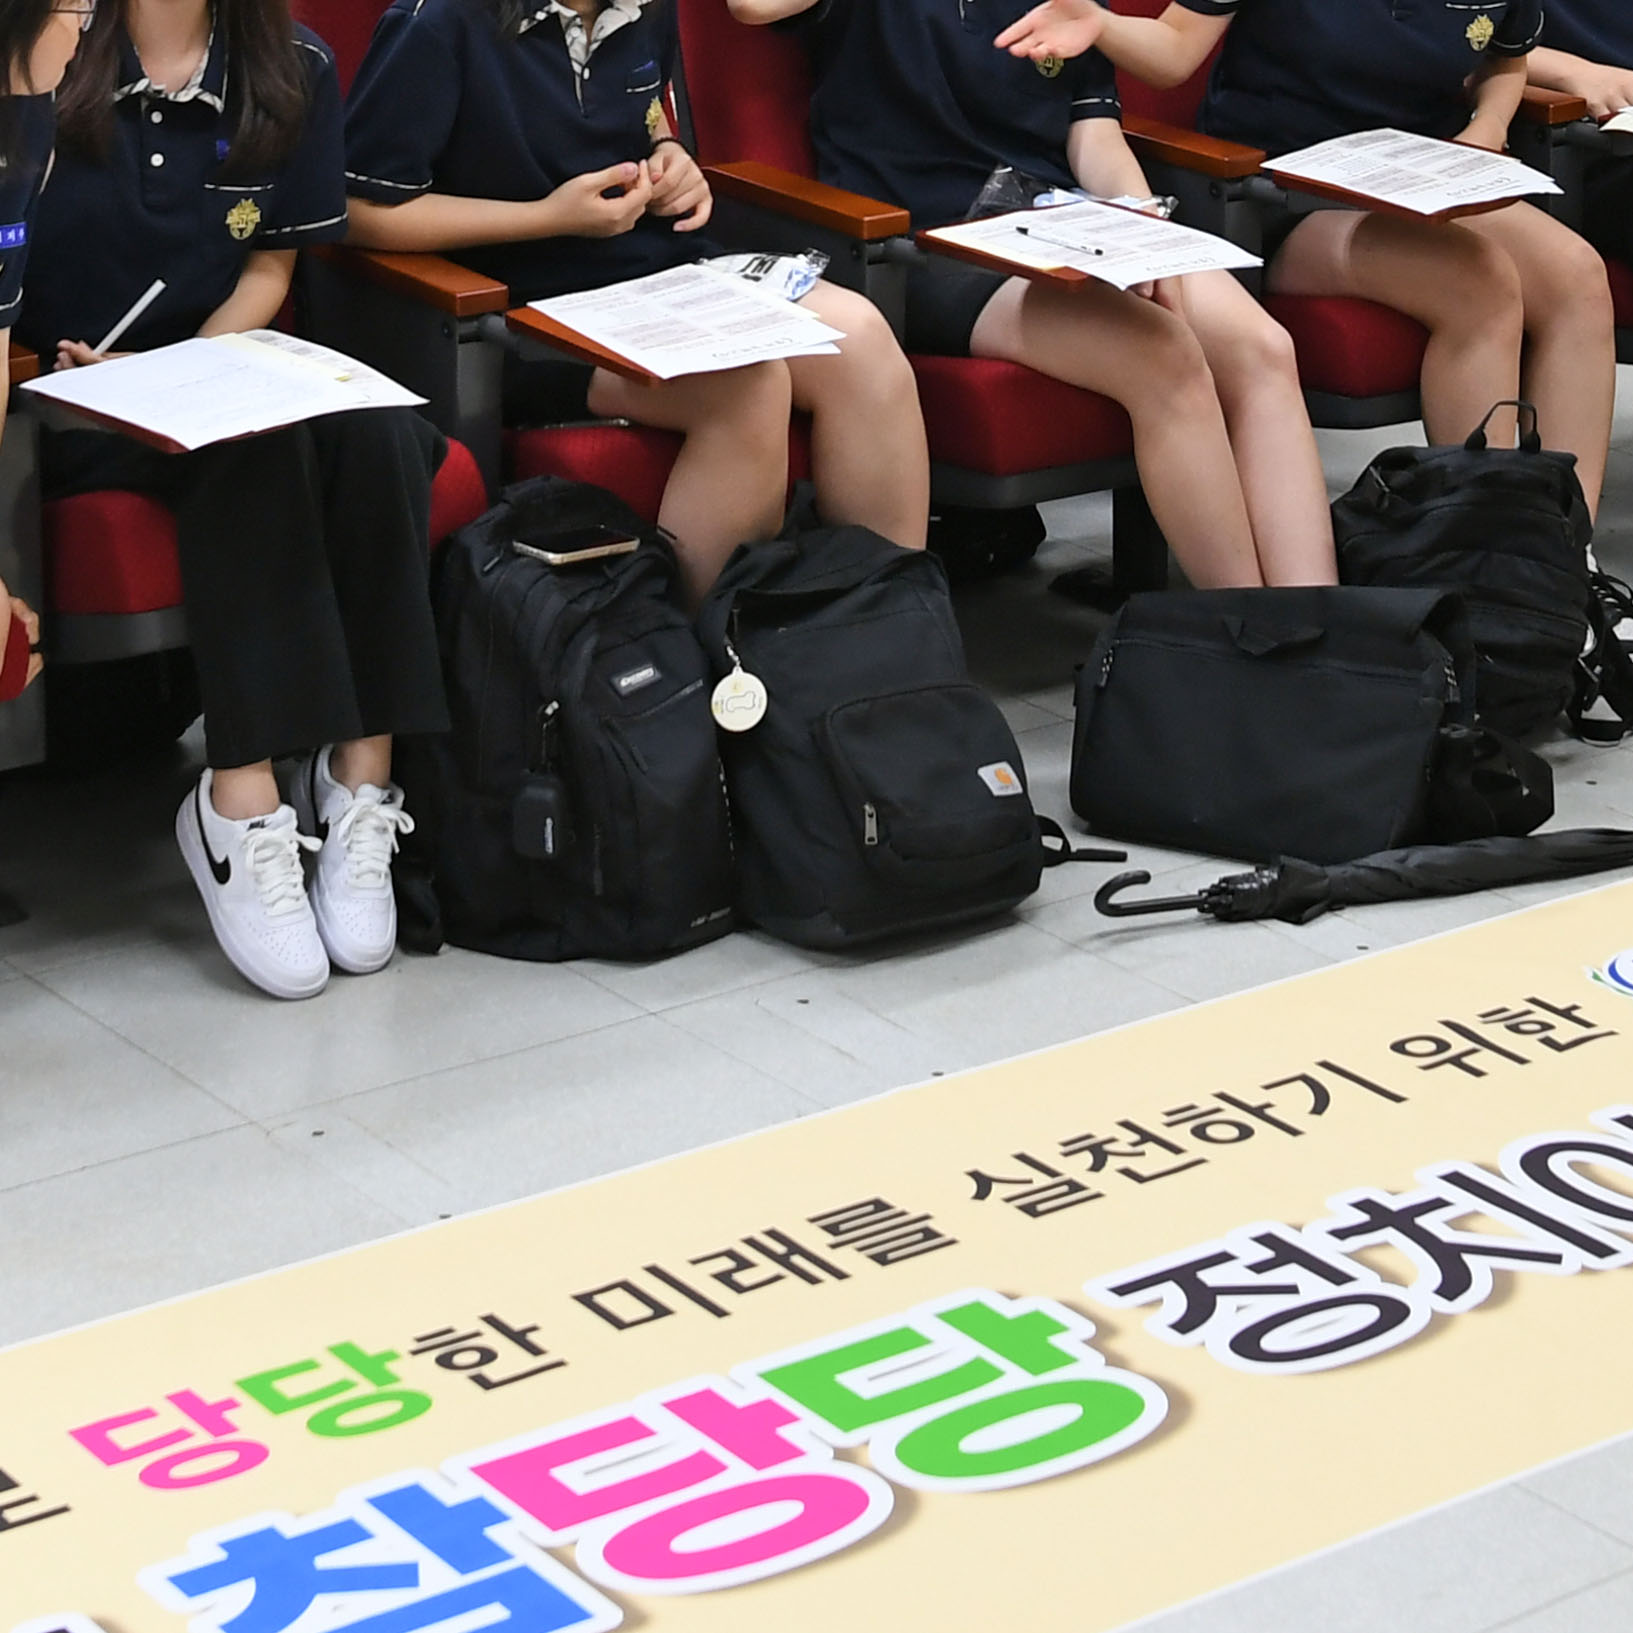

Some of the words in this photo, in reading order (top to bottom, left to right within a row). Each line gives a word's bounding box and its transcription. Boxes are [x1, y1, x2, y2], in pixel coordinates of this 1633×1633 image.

[66, 1312, 568, 1491] 당당한
[569, 1195, 959, 1332] 미래를
[964, 1058, 1409, 1221] 실천하기
[1386, 994, 1618, 1082] 위한
